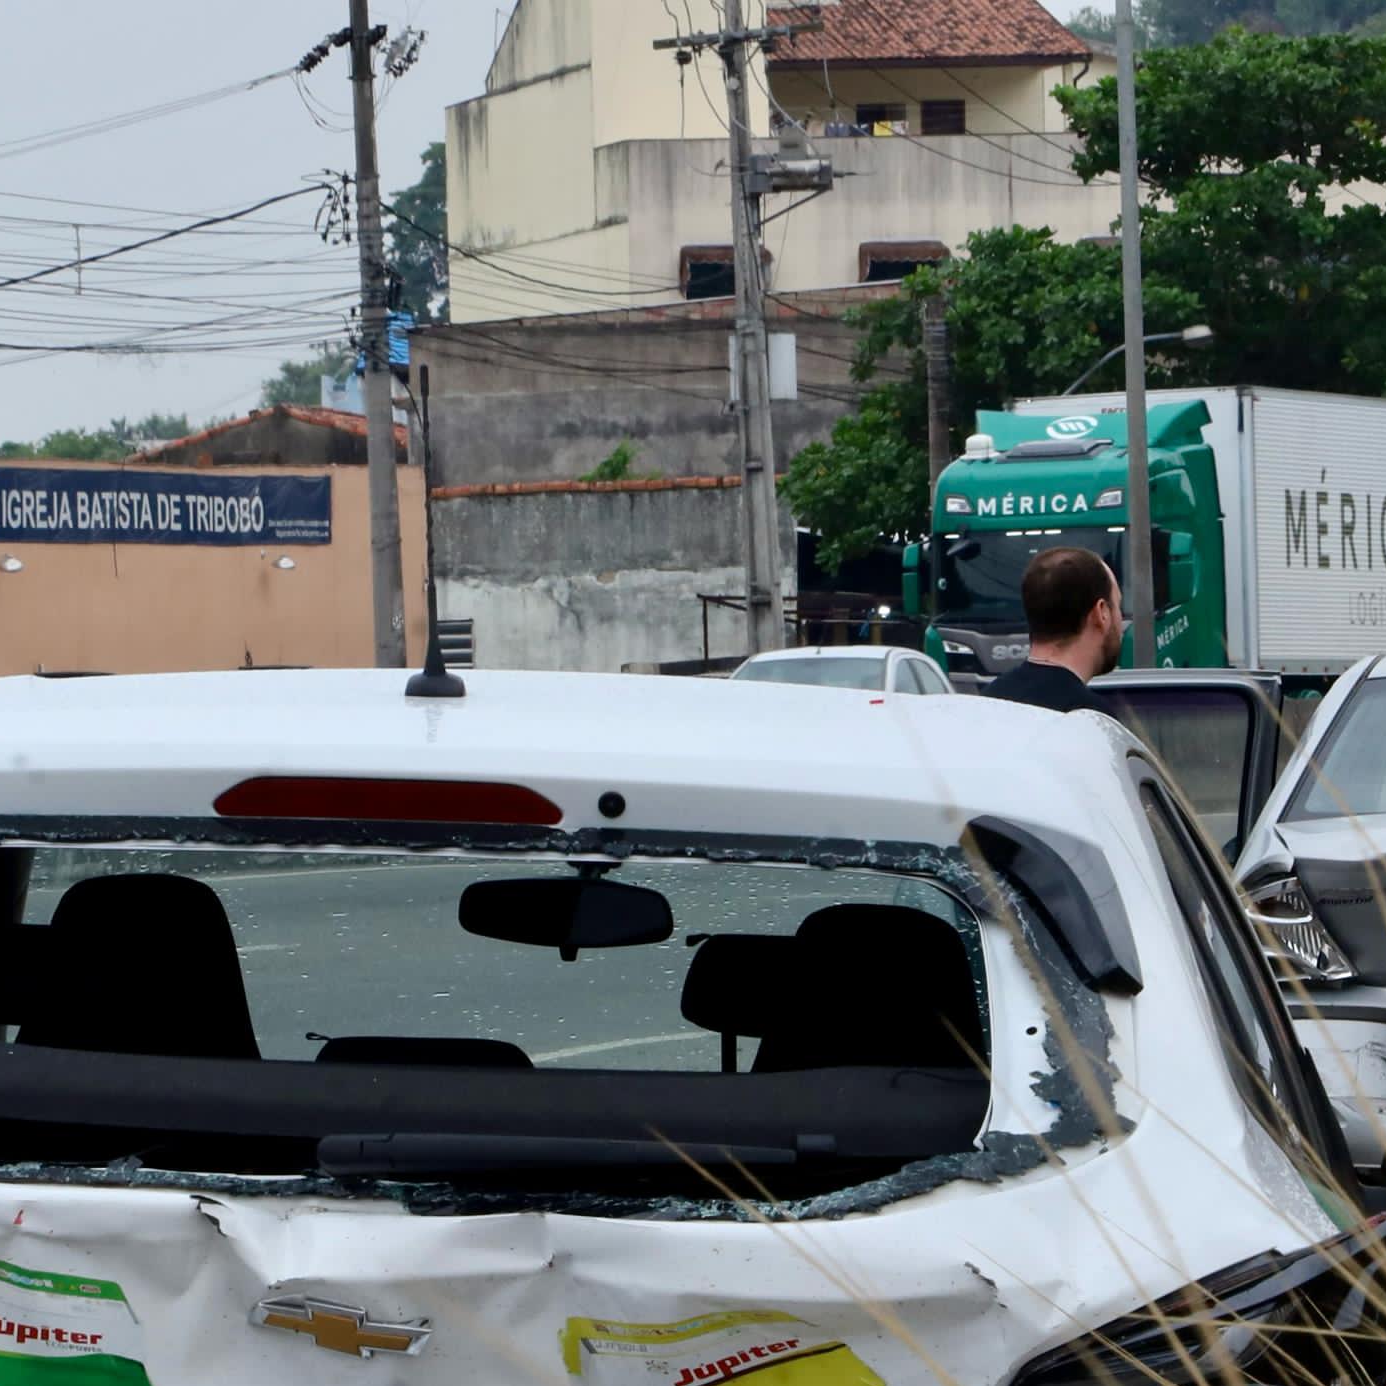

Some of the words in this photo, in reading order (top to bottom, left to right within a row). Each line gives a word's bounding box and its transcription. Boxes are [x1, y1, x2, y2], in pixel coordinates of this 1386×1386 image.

[1, 488, 73, 529] IGREJA
[76, 490, 154, 533] BATISTA
[157, 493, 182, 531] DE
[185, 486, 264, 534] TRIBOBÓ
[977, 491, 1089, 516] MÉRICA
[1156, 615, 1190, 648] MÉRICA
